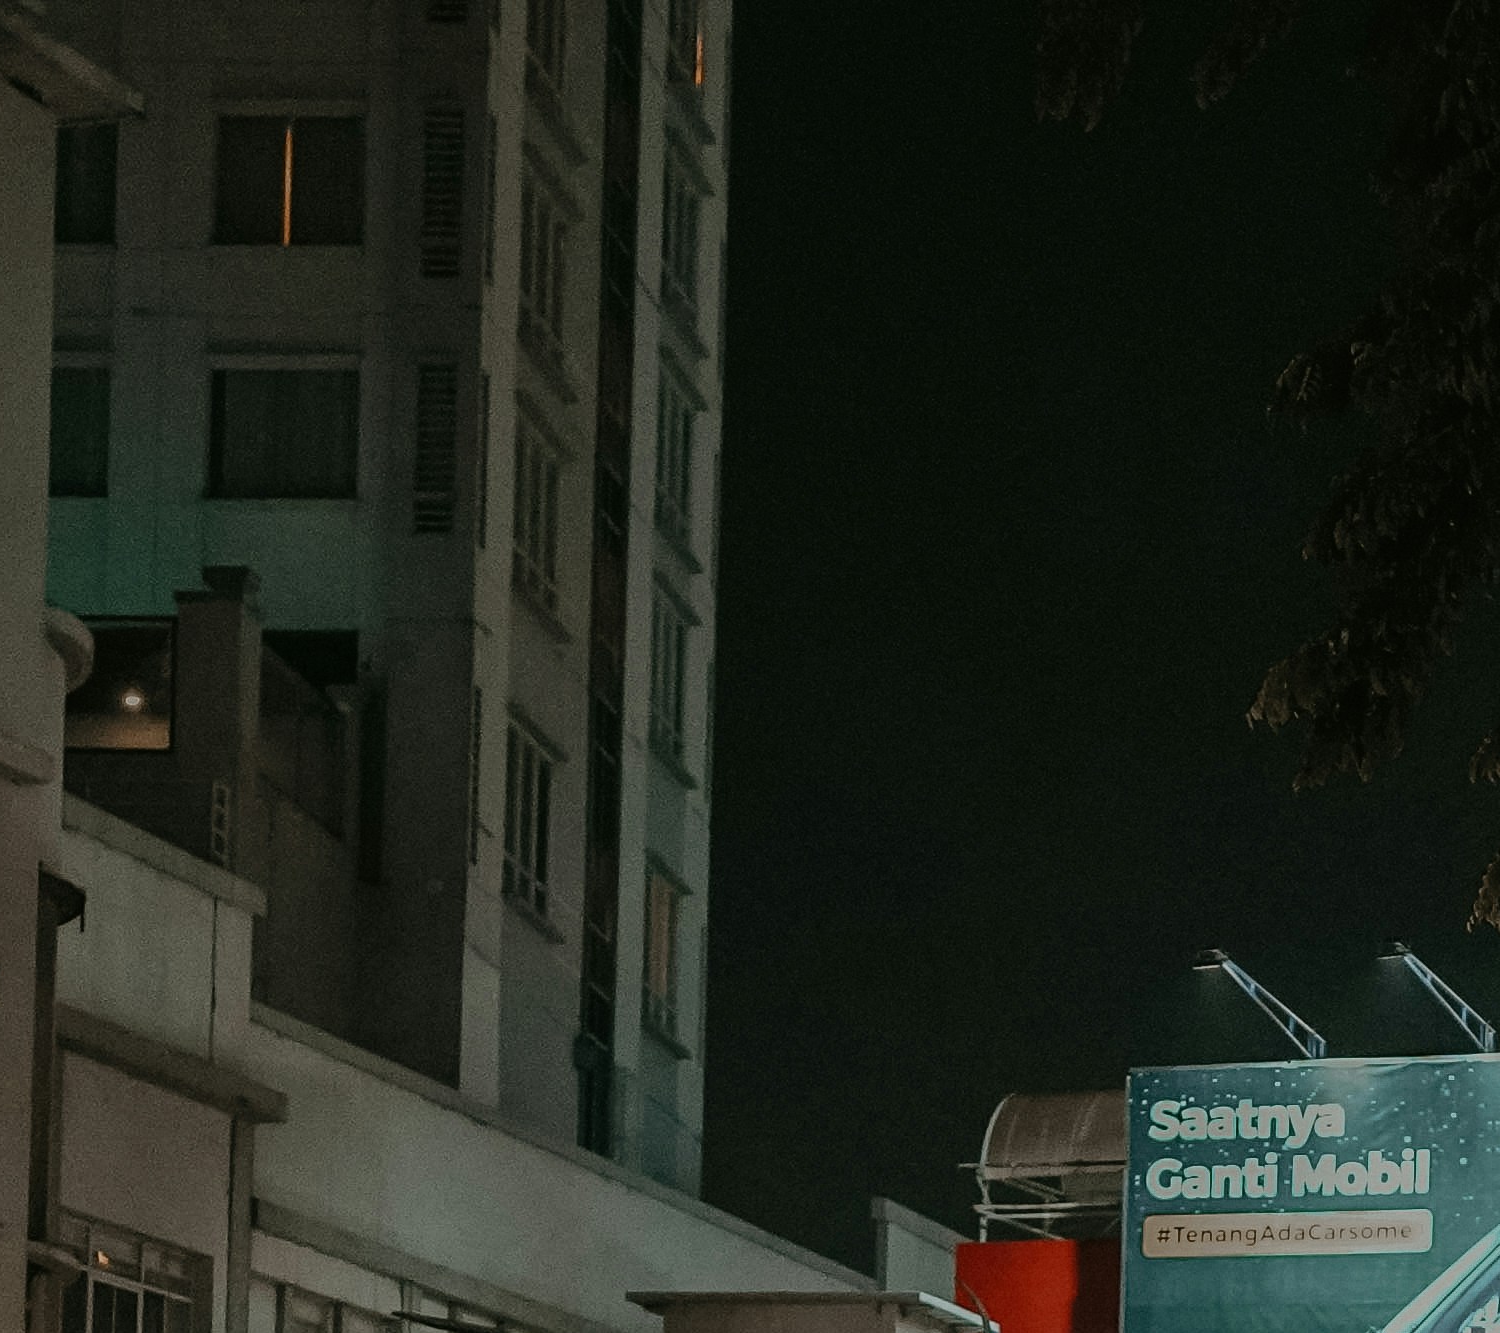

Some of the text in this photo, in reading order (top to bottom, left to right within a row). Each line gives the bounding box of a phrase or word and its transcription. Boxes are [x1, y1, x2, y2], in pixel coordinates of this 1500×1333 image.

[1148, 1099, 1346, 1149] Saatnya
[1146, 1148, 1431, 1200] Ganti Mobil
[1156, 1223, 1413, 1247] #TenangAdaCarsome
